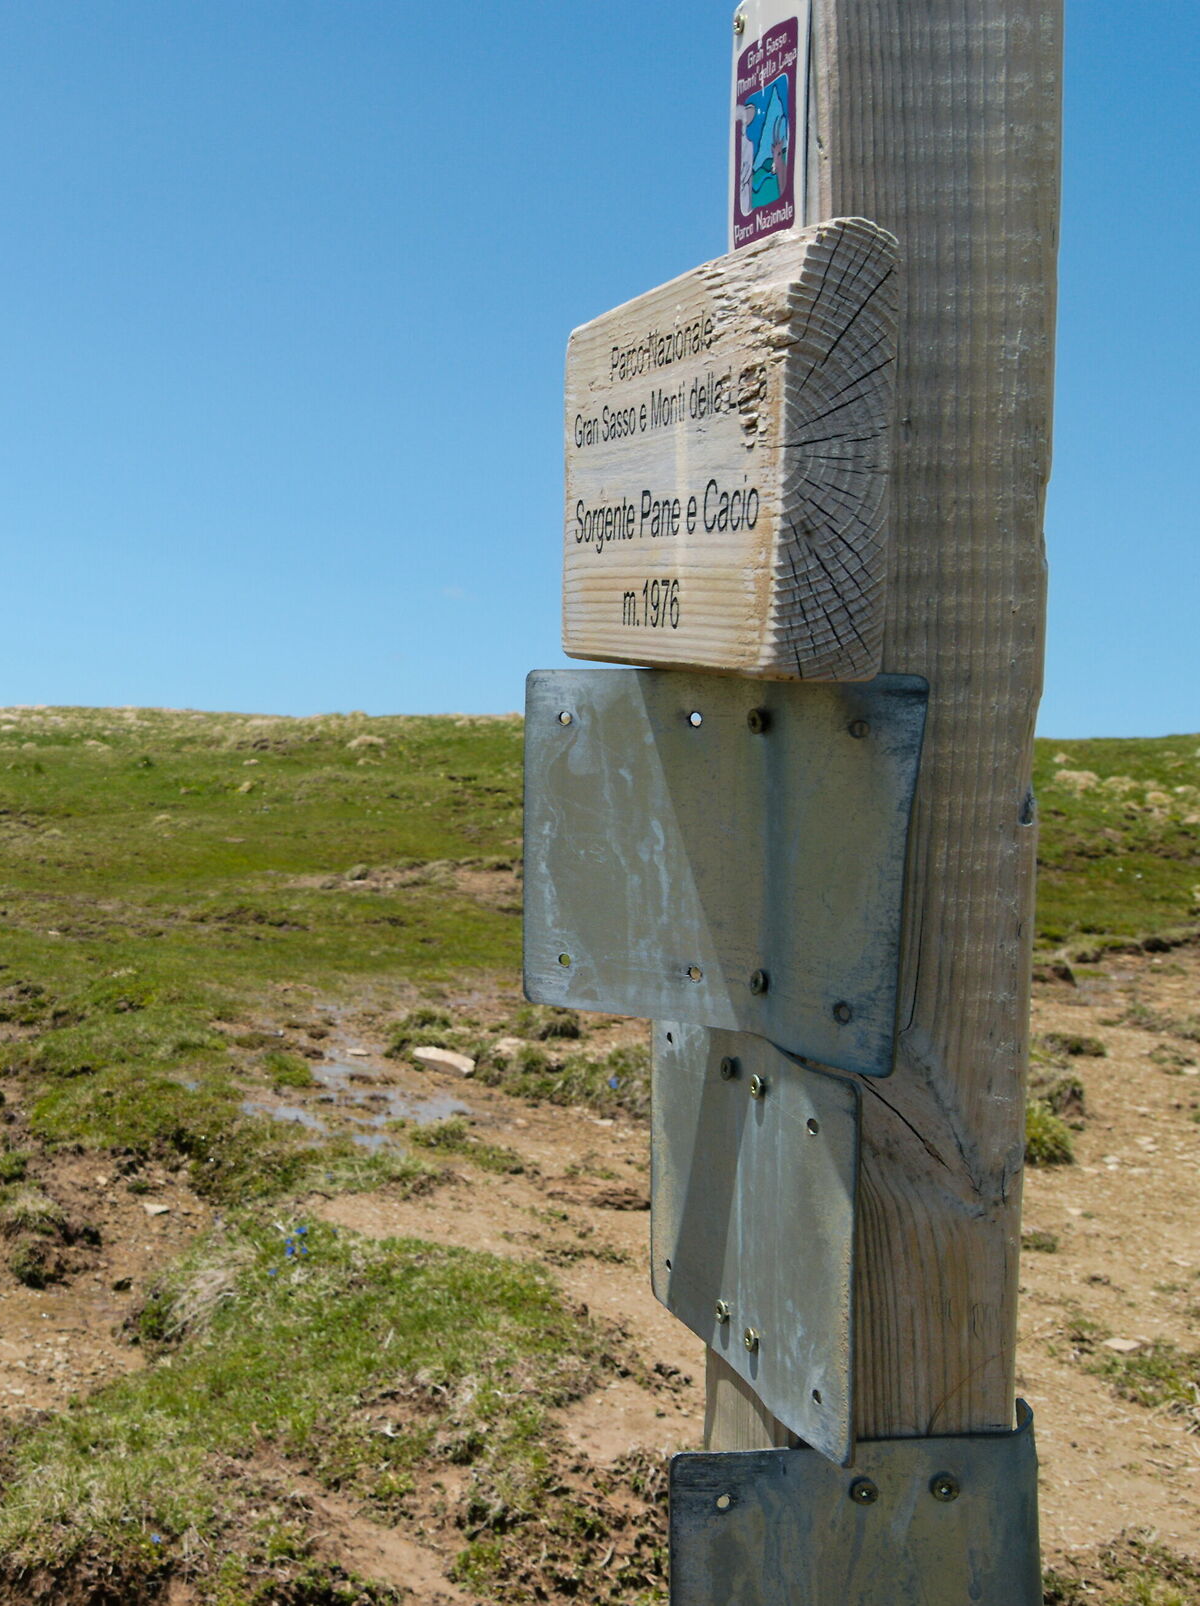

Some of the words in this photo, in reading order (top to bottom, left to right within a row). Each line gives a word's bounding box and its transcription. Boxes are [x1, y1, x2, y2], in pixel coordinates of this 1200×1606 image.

[747, 48, 764, 69] Gran
[766, 33, 788, 56] Sasso
[734, 223, 754, 244] Parco
[756, 201, 793, 232] Nazionale
[609, 344, 644, 382] Parco
[648, 309, 714, 371] Nazionale
[574, 413, 599, 448] Gran
[602, 404, 636, 442] Sasso
[639, 403, 647, 432] e
[650, 381, 686, 430] Monti
[689, 371, 723, 420] della
[728, 364, 767, 414] La
[575, 496, 636, 554] Sorgente
[640, 489, 681, 538] Pane
[686, 495, 697, 535] e
[703, 474, 760, 533] Cacio
[622, 578, 680, 630] m.1976
